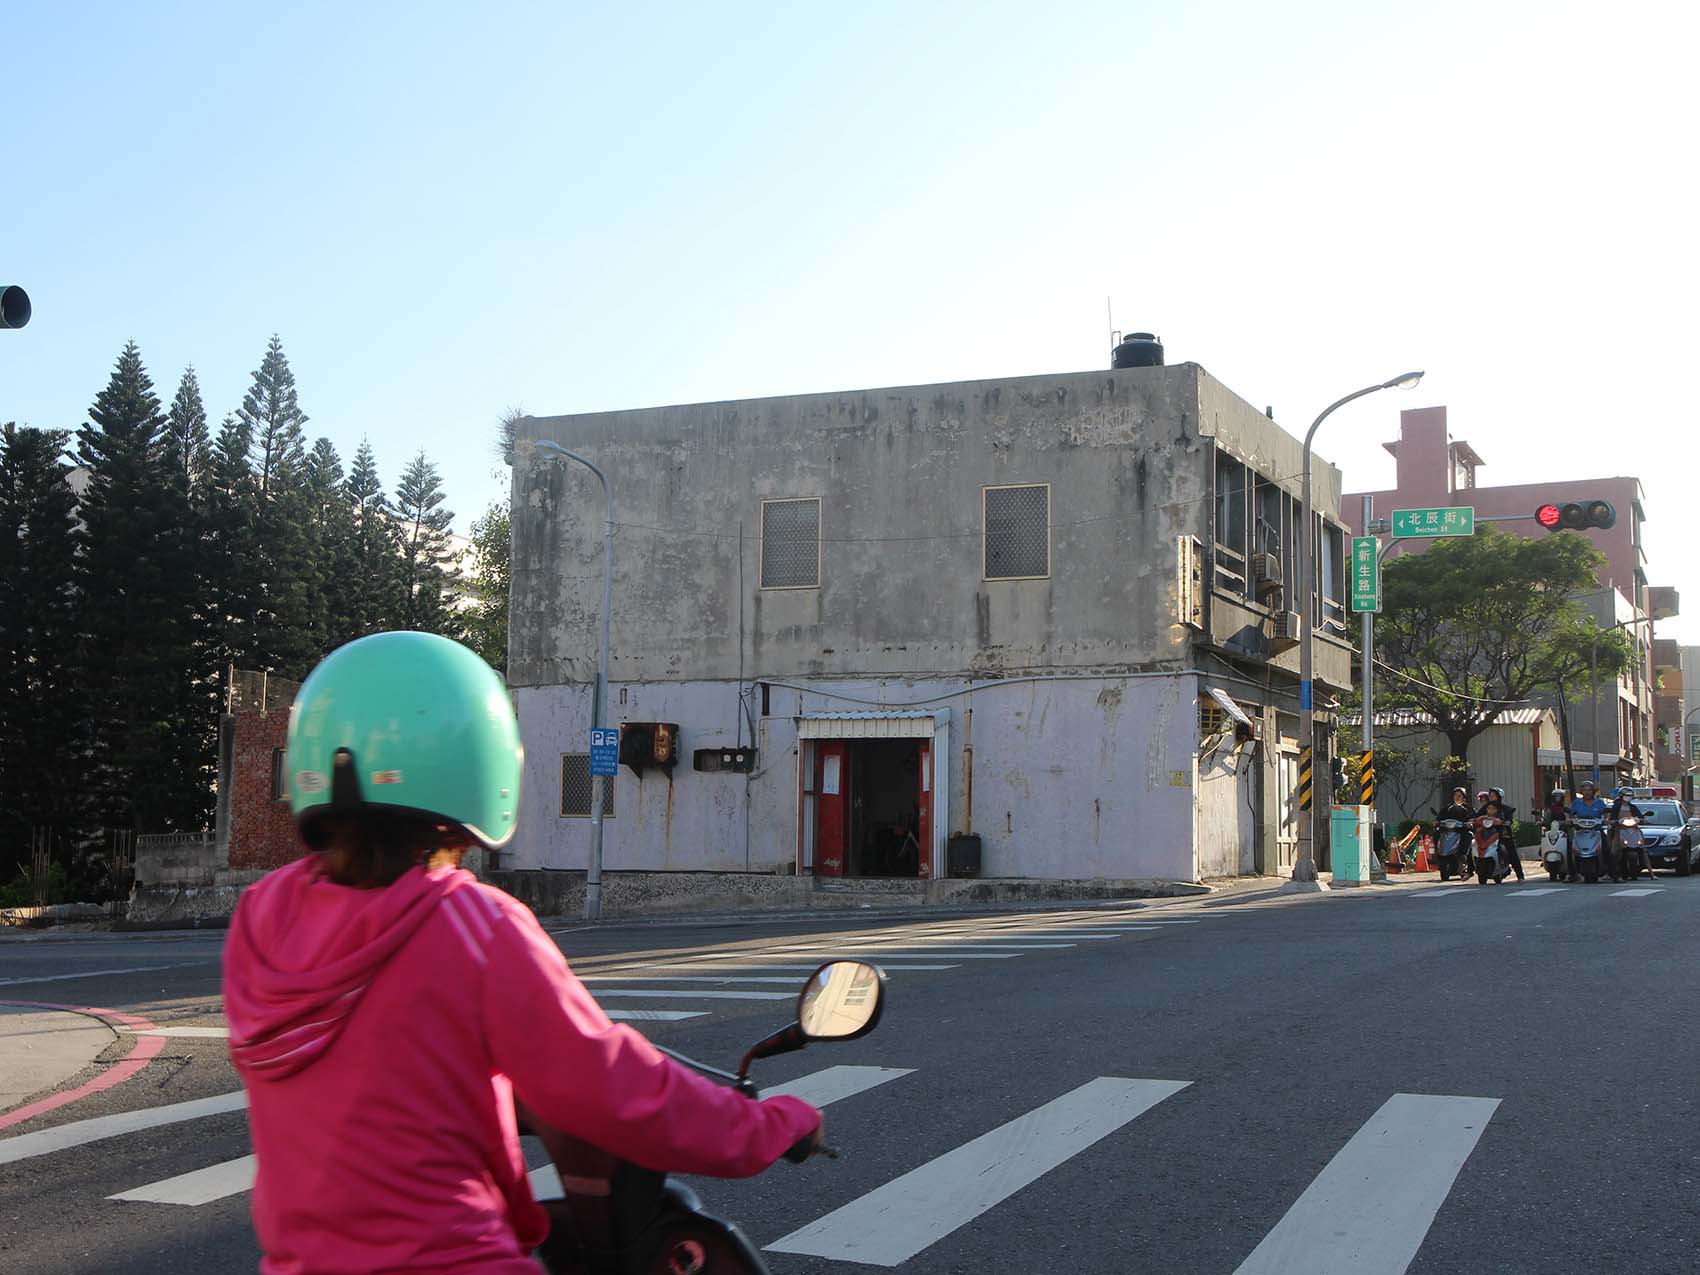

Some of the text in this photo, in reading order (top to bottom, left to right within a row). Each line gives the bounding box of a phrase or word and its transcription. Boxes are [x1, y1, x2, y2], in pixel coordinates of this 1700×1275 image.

[1408, 511, 1457, 525] 北辰街
[1358, 550, 1371, 592] 新生路
[593, 732, 602, 745] P
